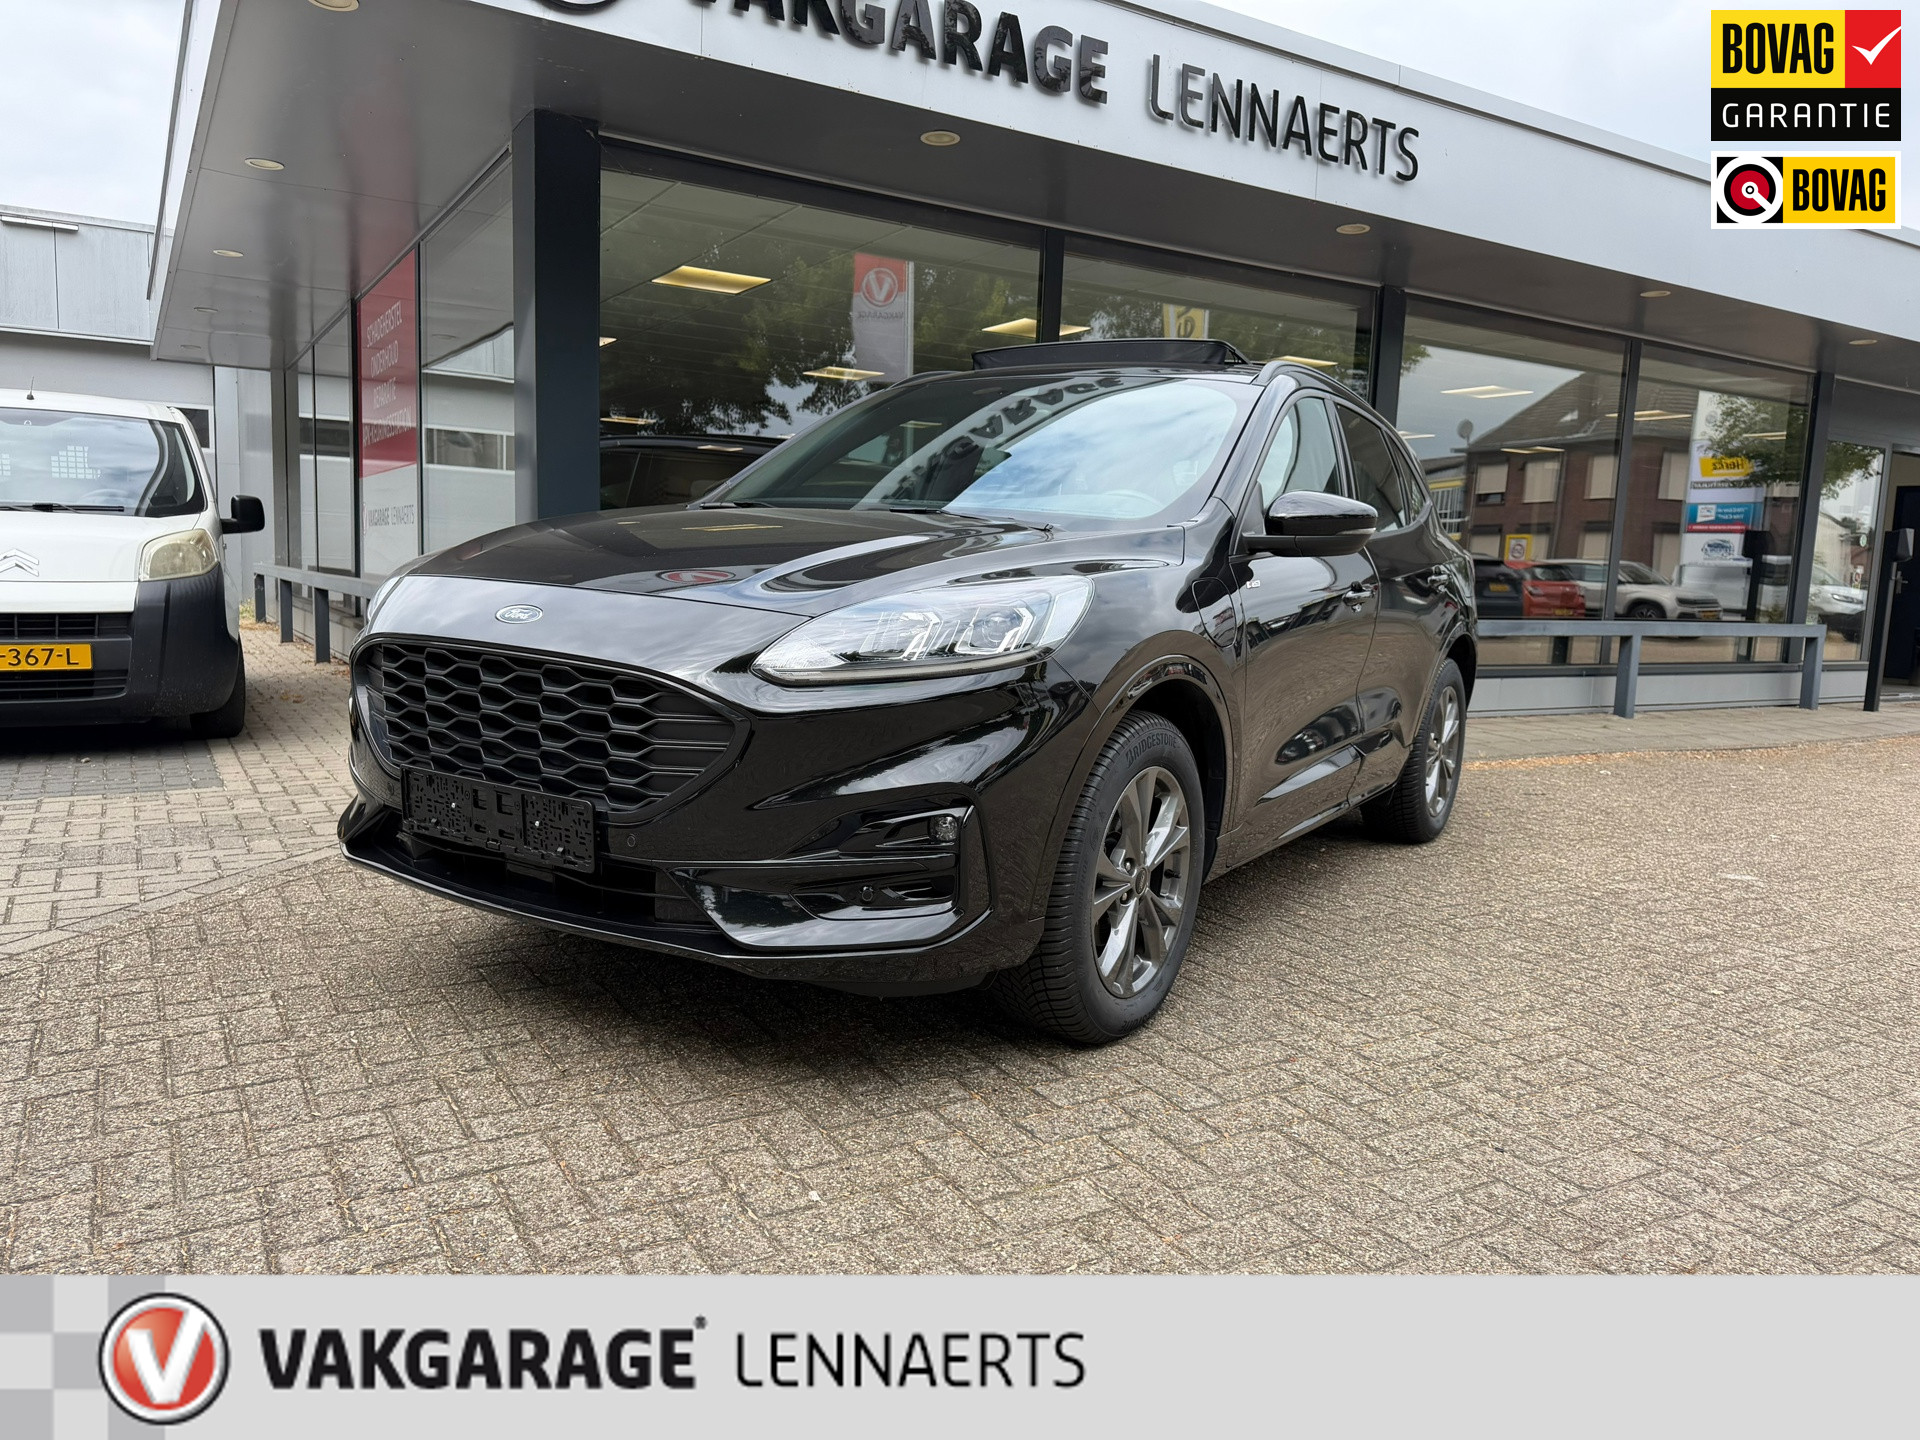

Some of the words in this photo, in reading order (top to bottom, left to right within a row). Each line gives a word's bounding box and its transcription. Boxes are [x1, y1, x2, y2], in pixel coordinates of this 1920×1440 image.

[694, 0, 1108, 104] GARAGE
[1151, 53, 1420, 183] LENNAERTS
[504, 608, 533, 620] Ford
[1125, 732, 1177, 769] BRIDGESTONE
